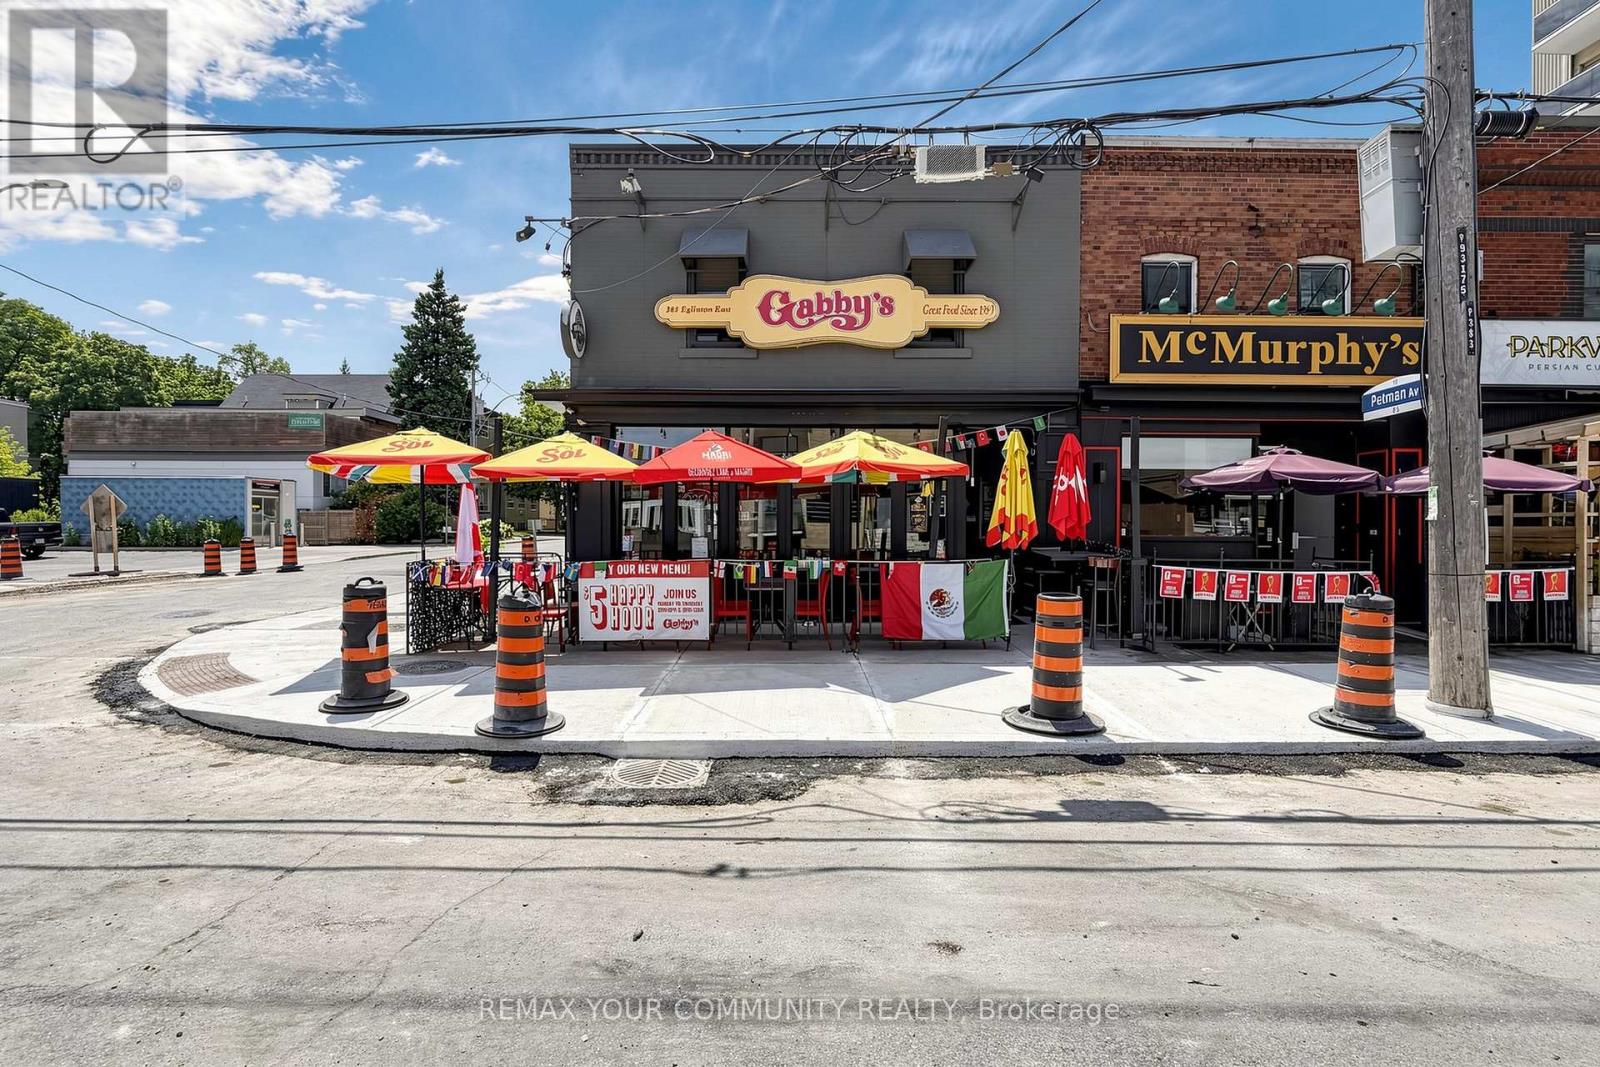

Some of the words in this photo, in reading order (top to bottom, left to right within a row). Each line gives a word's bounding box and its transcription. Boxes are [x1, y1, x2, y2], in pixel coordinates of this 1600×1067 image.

[757, 288, 895, 332] Gabby's
[922, 304, 942, 315] Great
[942, 304, 959, 315] Food
[960, 304, 978, 315] Since
[1137, 329, 1420, 375] McMurphy's
[1528, 363, 1579, 371] PERSIAN
[1371, 389, 1407, 408] Petman
[616, 563, 636, 575] OUR
[638, 563, 658, 575] NEW
[661, 563, 691, 575] MENU!
[610, 584, 655, 607] HAPPY
[663, 589, 684, 599] JOIN
[685, 589, 697, 599] US
[610, 606, 655, 631] HOUR
